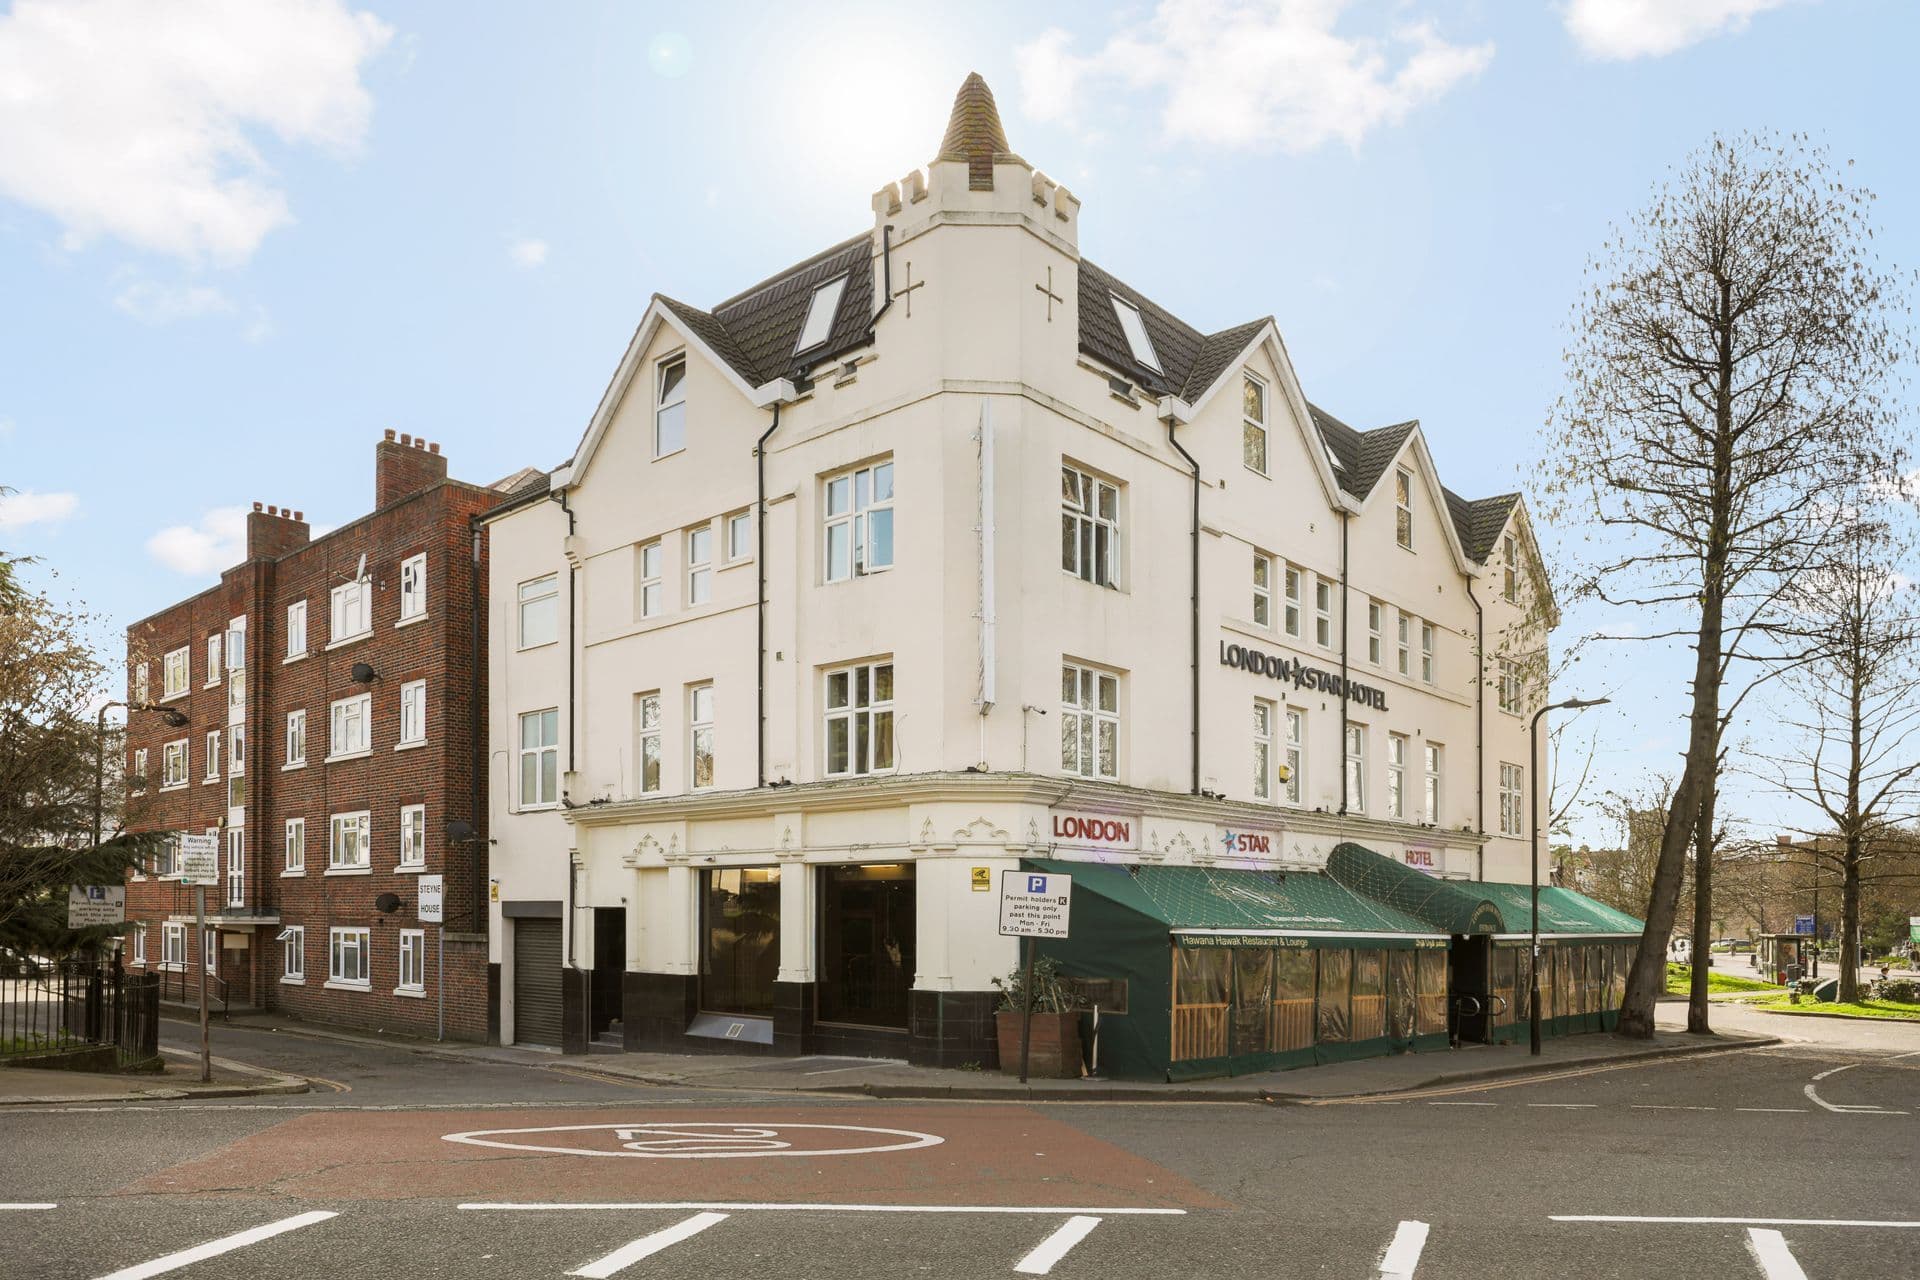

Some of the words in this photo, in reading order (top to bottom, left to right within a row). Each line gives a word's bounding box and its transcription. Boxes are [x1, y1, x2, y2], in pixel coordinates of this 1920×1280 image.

[1220, 639, 1290, 682] LONDON
[1305, 666, 1343, 697] STAR
[1345, 679, 1389, 712] HOTEL
[1053, 815, 1130, 842] LONDON
[187, 837, 211, 846] Warning
[1238, 834, 1270, 853] STAR
[1405, 850, 1434, 866] HOTEL
[420, 884, 441, 894] STEYNE
[420, 904, 440, 913] HOUSE
[1182, 935, 1214, 945] Hawana
[1242, 936, 1279, 946] Restaurant
[1286, 937, 1309, 948] Lounge
